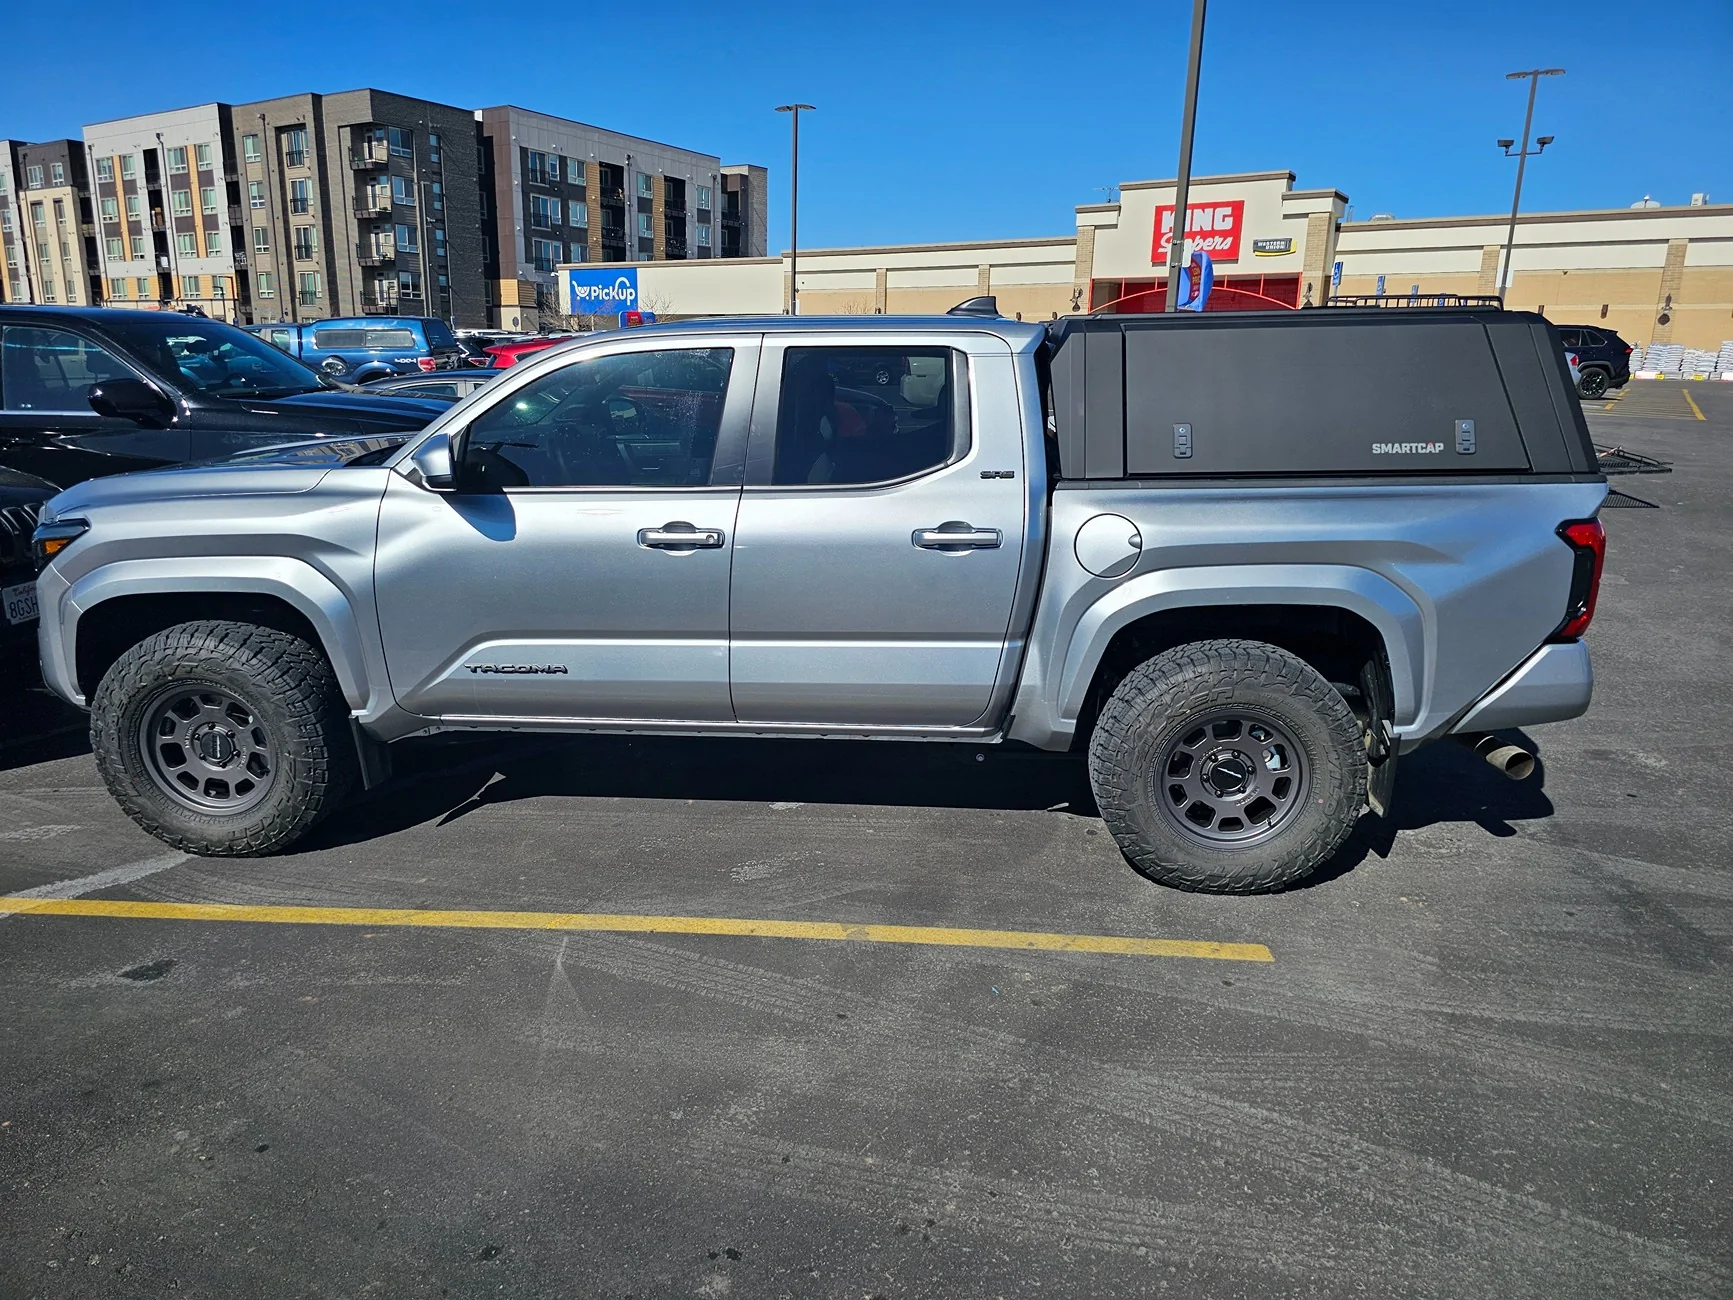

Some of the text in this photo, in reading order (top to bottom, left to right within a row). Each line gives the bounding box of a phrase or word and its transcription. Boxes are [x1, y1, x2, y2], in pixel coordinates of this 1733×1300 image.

[1371, 442, 1445, 454] SMARTCAP
[980, 470, 1015, 479] SR5
[464, 663, 569, 675] TACOMA
